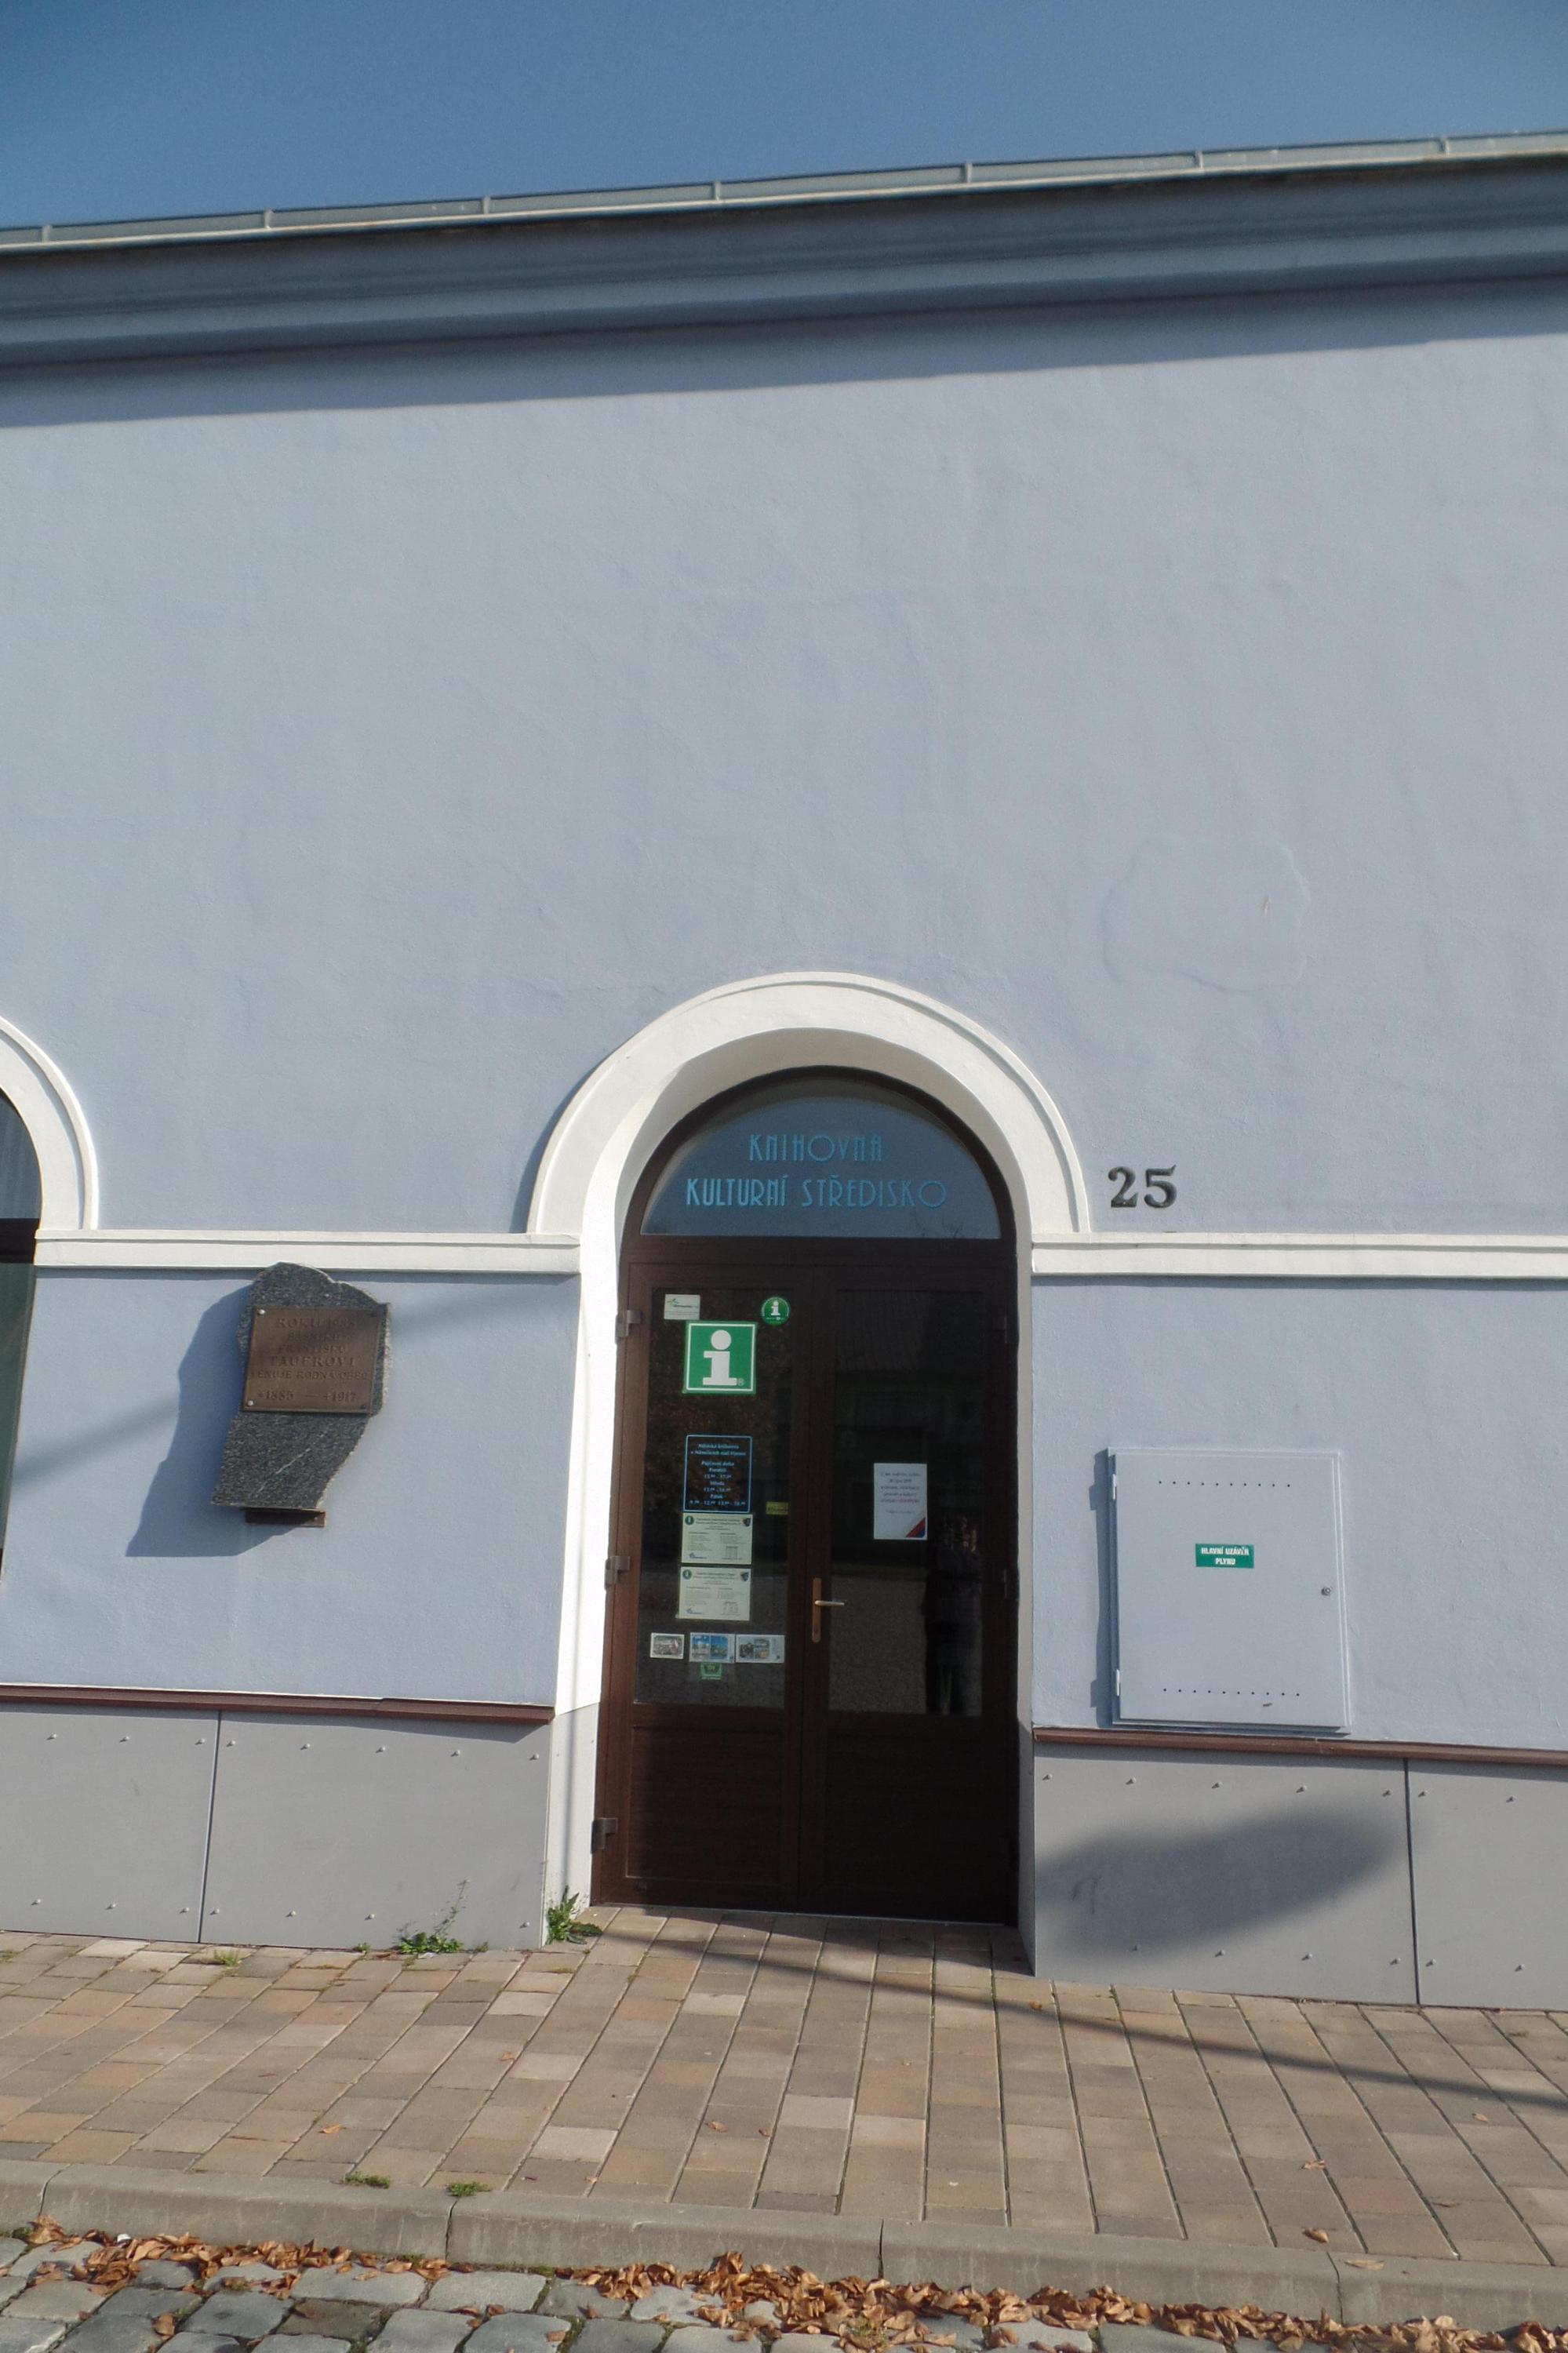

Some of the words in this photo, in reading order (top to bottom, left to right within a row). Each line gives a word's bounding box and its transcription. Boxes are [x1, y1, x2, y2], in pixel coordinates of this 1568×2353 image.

[749, 1134, 882, 1162] KNIHOVNA
[686, 1174, 789, 1207] KULTURNÍ
[802, 1175, 947, 1208] STŘEDISKO
[1108, 1165, 1177, 1209] 25
